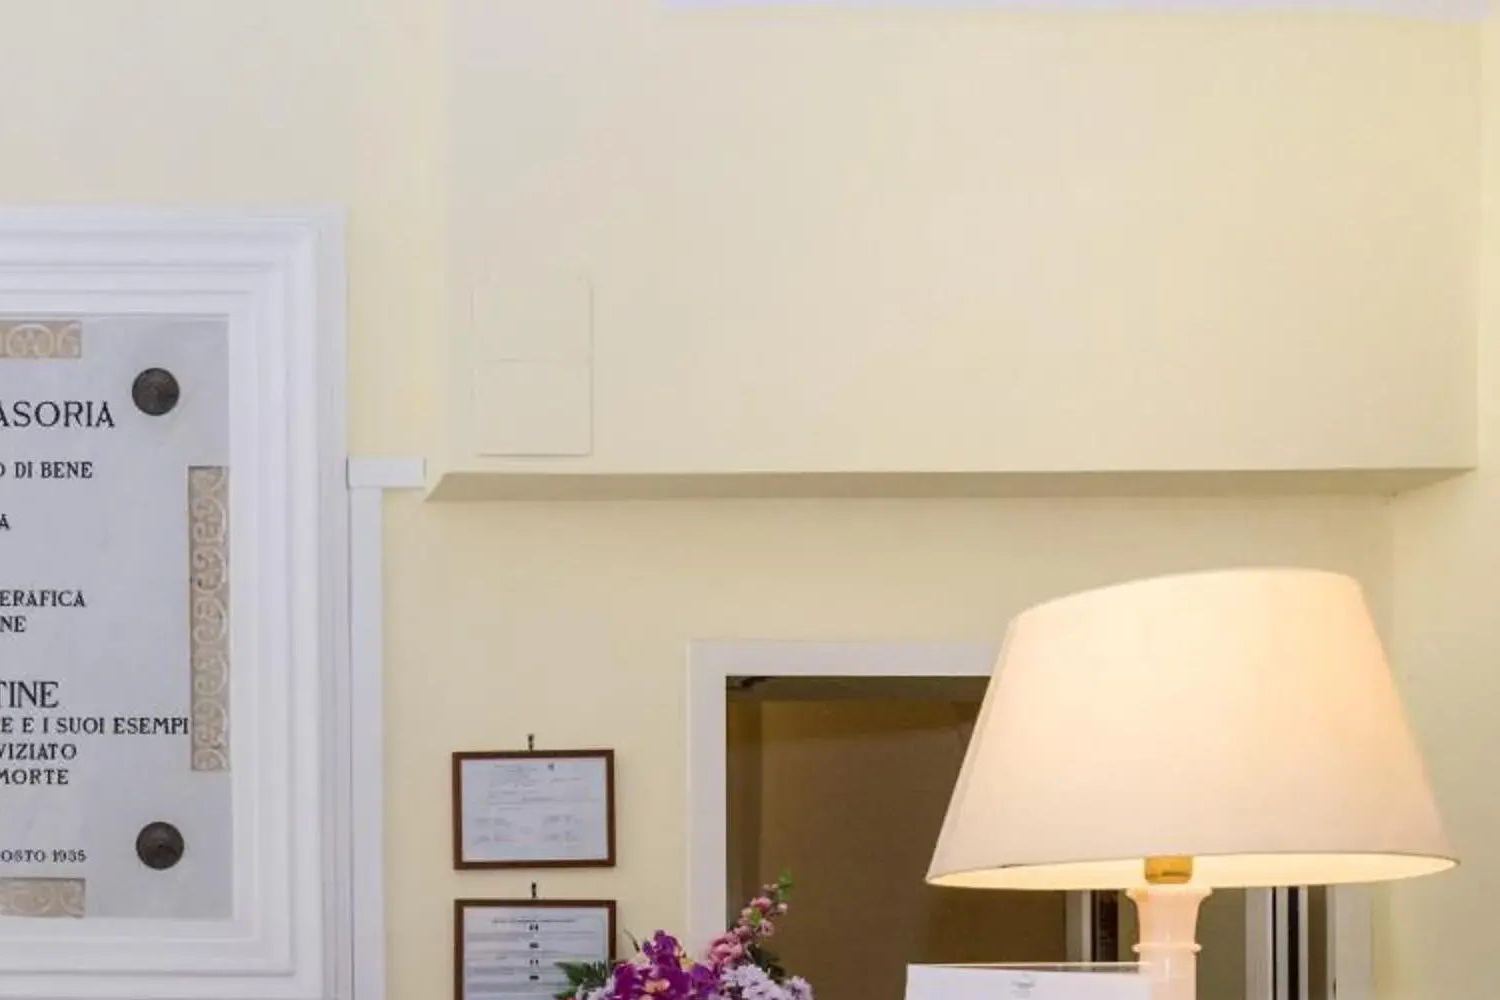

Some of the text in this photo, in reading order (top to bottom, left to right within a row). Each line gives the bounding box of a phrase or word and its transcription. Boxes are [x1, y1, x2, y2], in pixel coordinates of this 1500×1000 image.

[13, 460, 34, 480] DI
[39, 460, 93, 480] BENE
[21, 716, 35, 735] E
[42, 716, 49, 735] I
[55, 716, 106, 736] SUOI
[112, 716, 189, 736] ESEMPI
[52, 849, 88, 864] 1935
